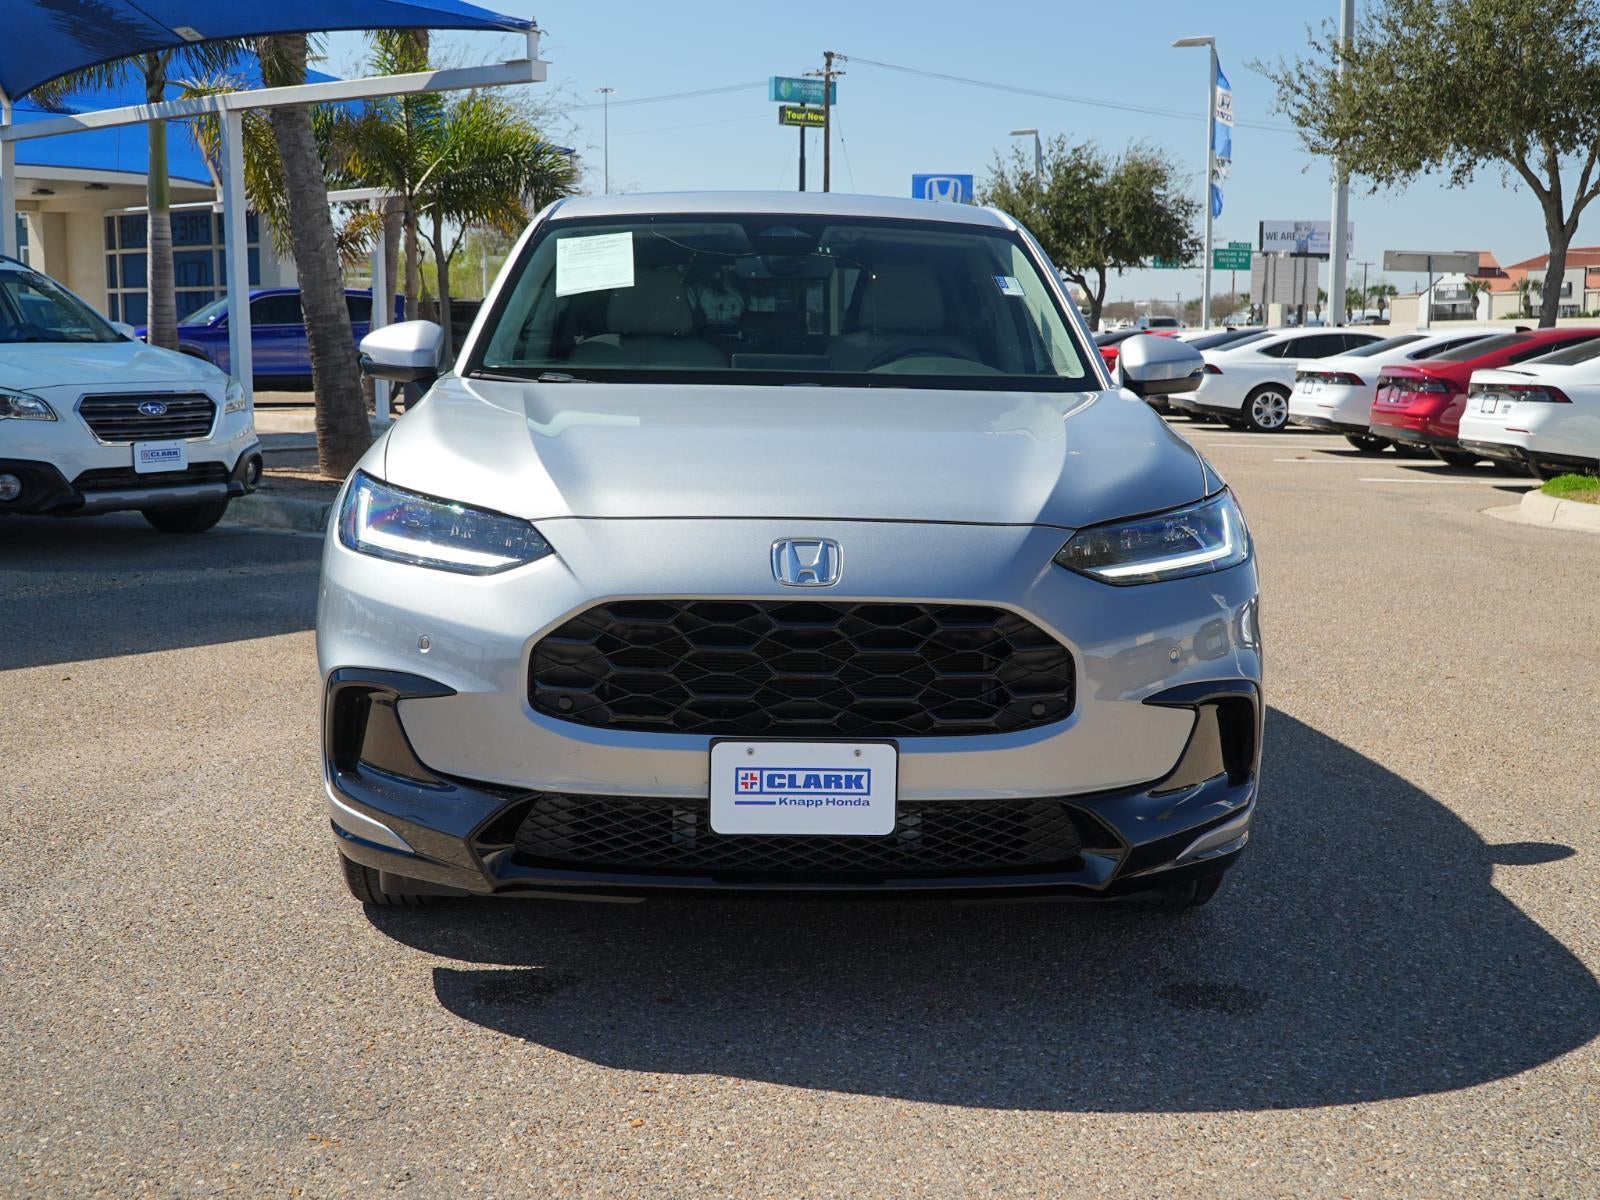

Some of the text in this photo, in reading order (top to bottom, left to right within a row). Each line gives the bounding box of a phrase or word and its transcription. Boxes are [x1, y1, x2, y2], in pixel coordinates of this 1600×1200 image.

[786, 110, 825, 121] Tour Now
[1265, 232, 1297, 241] WE ARE
[150, 450, 178, 458] CLARK
[766, 773, 865, 790] CLARK
[778, 797, 870, 808] Knapp Honda
